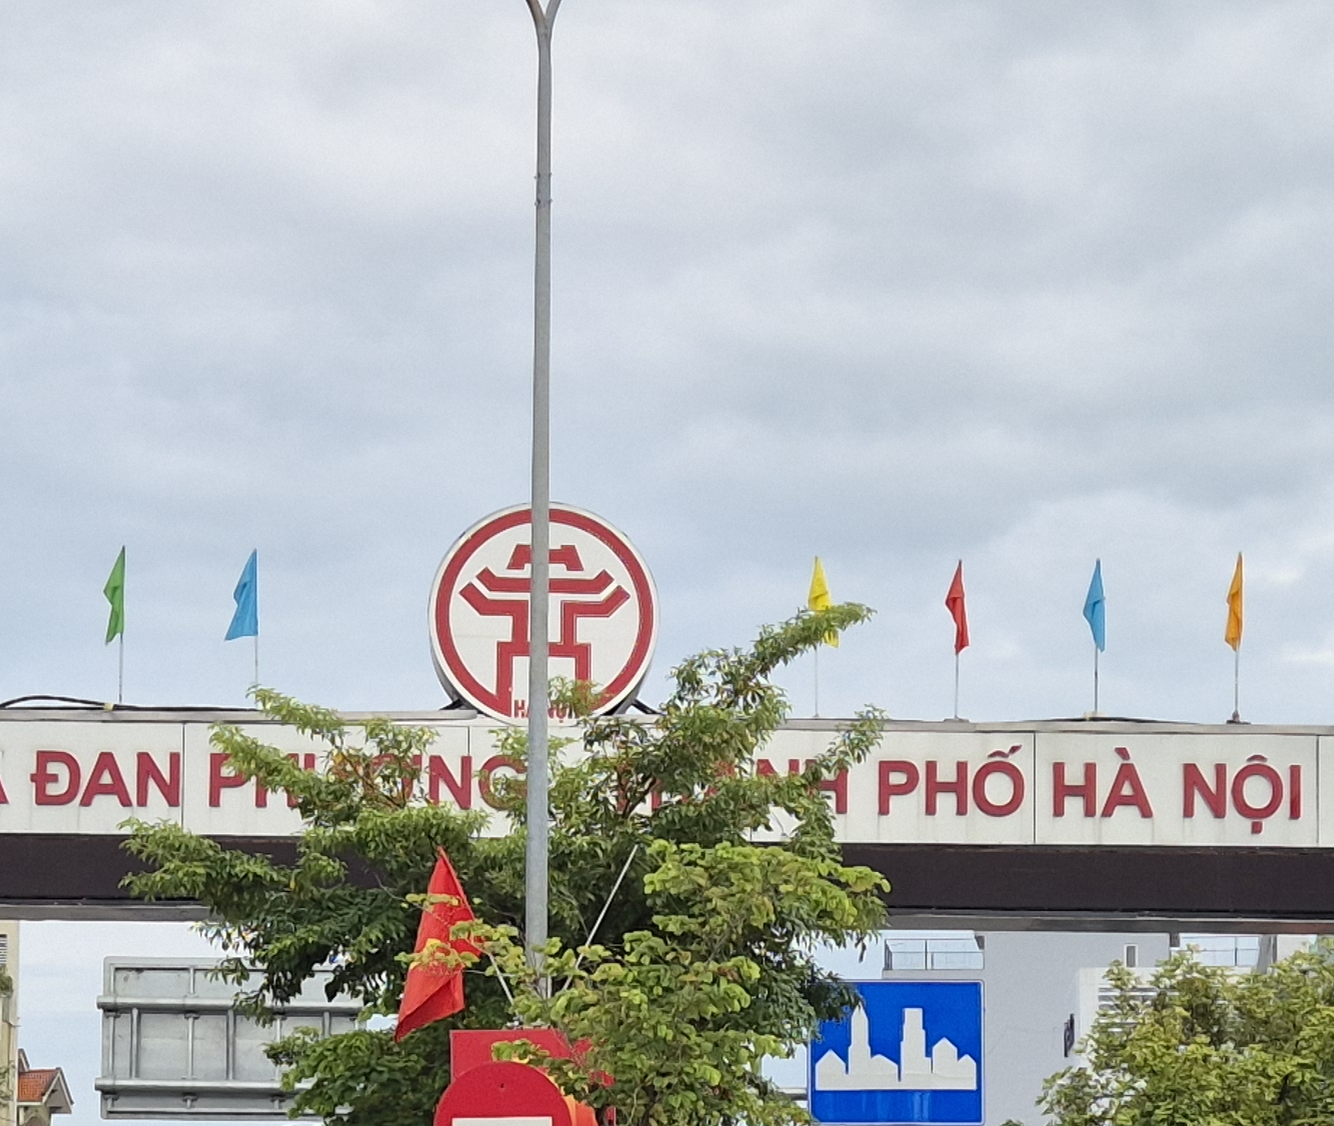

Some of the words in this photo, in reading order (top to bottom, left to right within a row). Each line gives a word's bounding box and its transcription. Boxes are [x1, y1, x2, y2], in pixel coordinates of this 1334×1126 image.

[30, 750, 181, 808] ĐAN
[877, 744, 1025, 817] PHỐ
[1052, 747, 1153, 818] HÀ
[1183, 754, 1302, 835] NỘI
